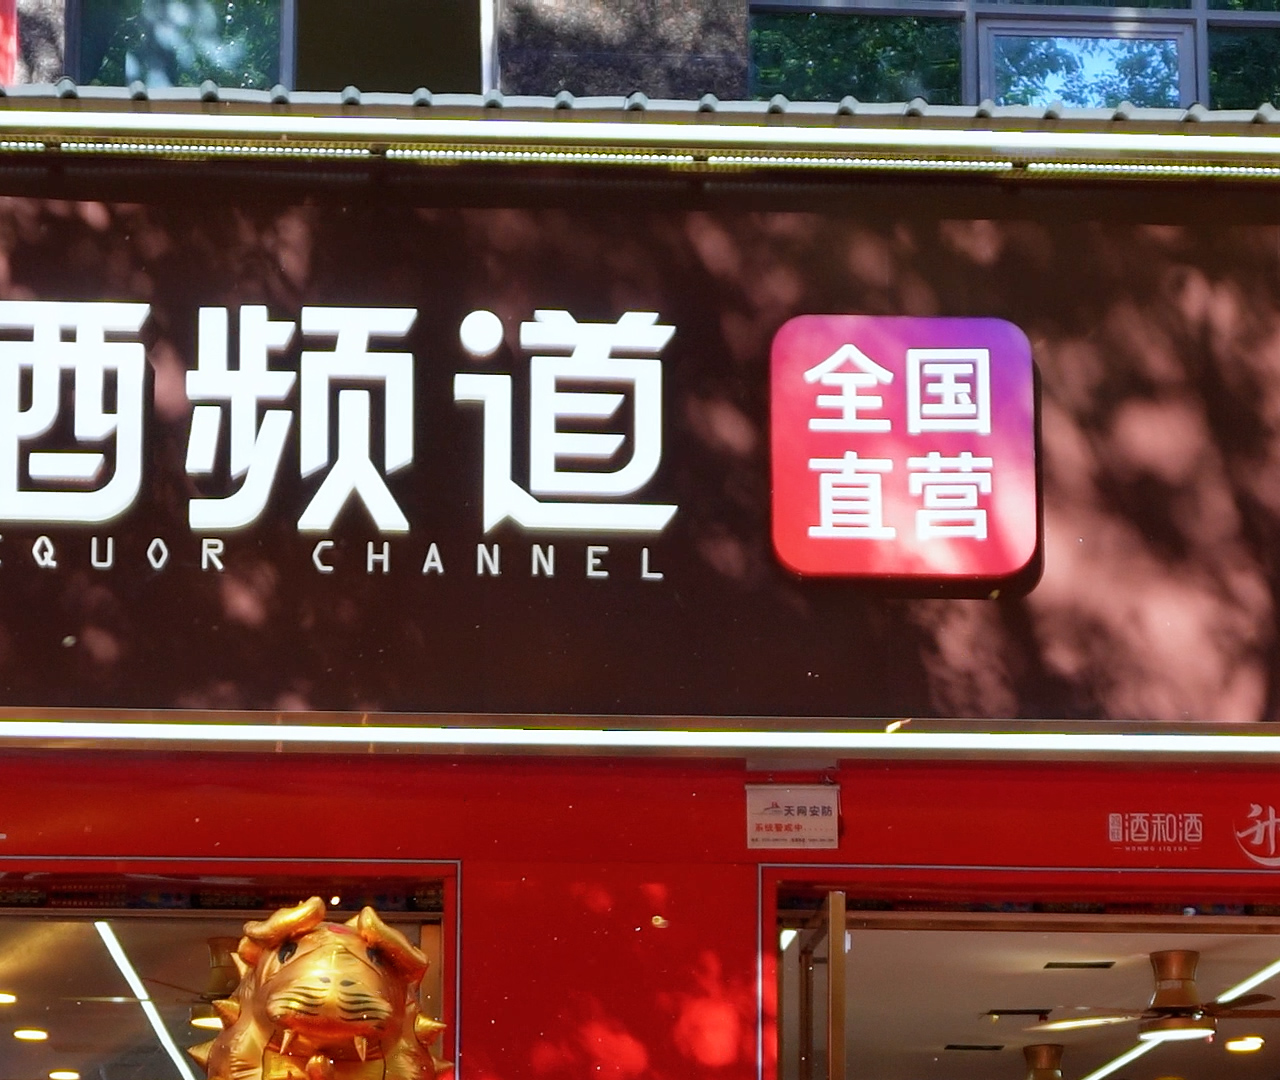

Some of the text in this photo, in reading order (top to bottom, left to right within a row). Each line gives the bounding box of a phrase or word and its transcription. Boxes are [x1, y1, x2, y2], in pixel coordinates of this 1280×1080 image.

[803, 343, 992, 436] 全国
[807, 450, 997, 541] 直营
[310, 540, 665, 580] CHANNEL
[783, 804, 834, 817] 天网安防
[1124, 813, 1204, 842] 酒和酒
